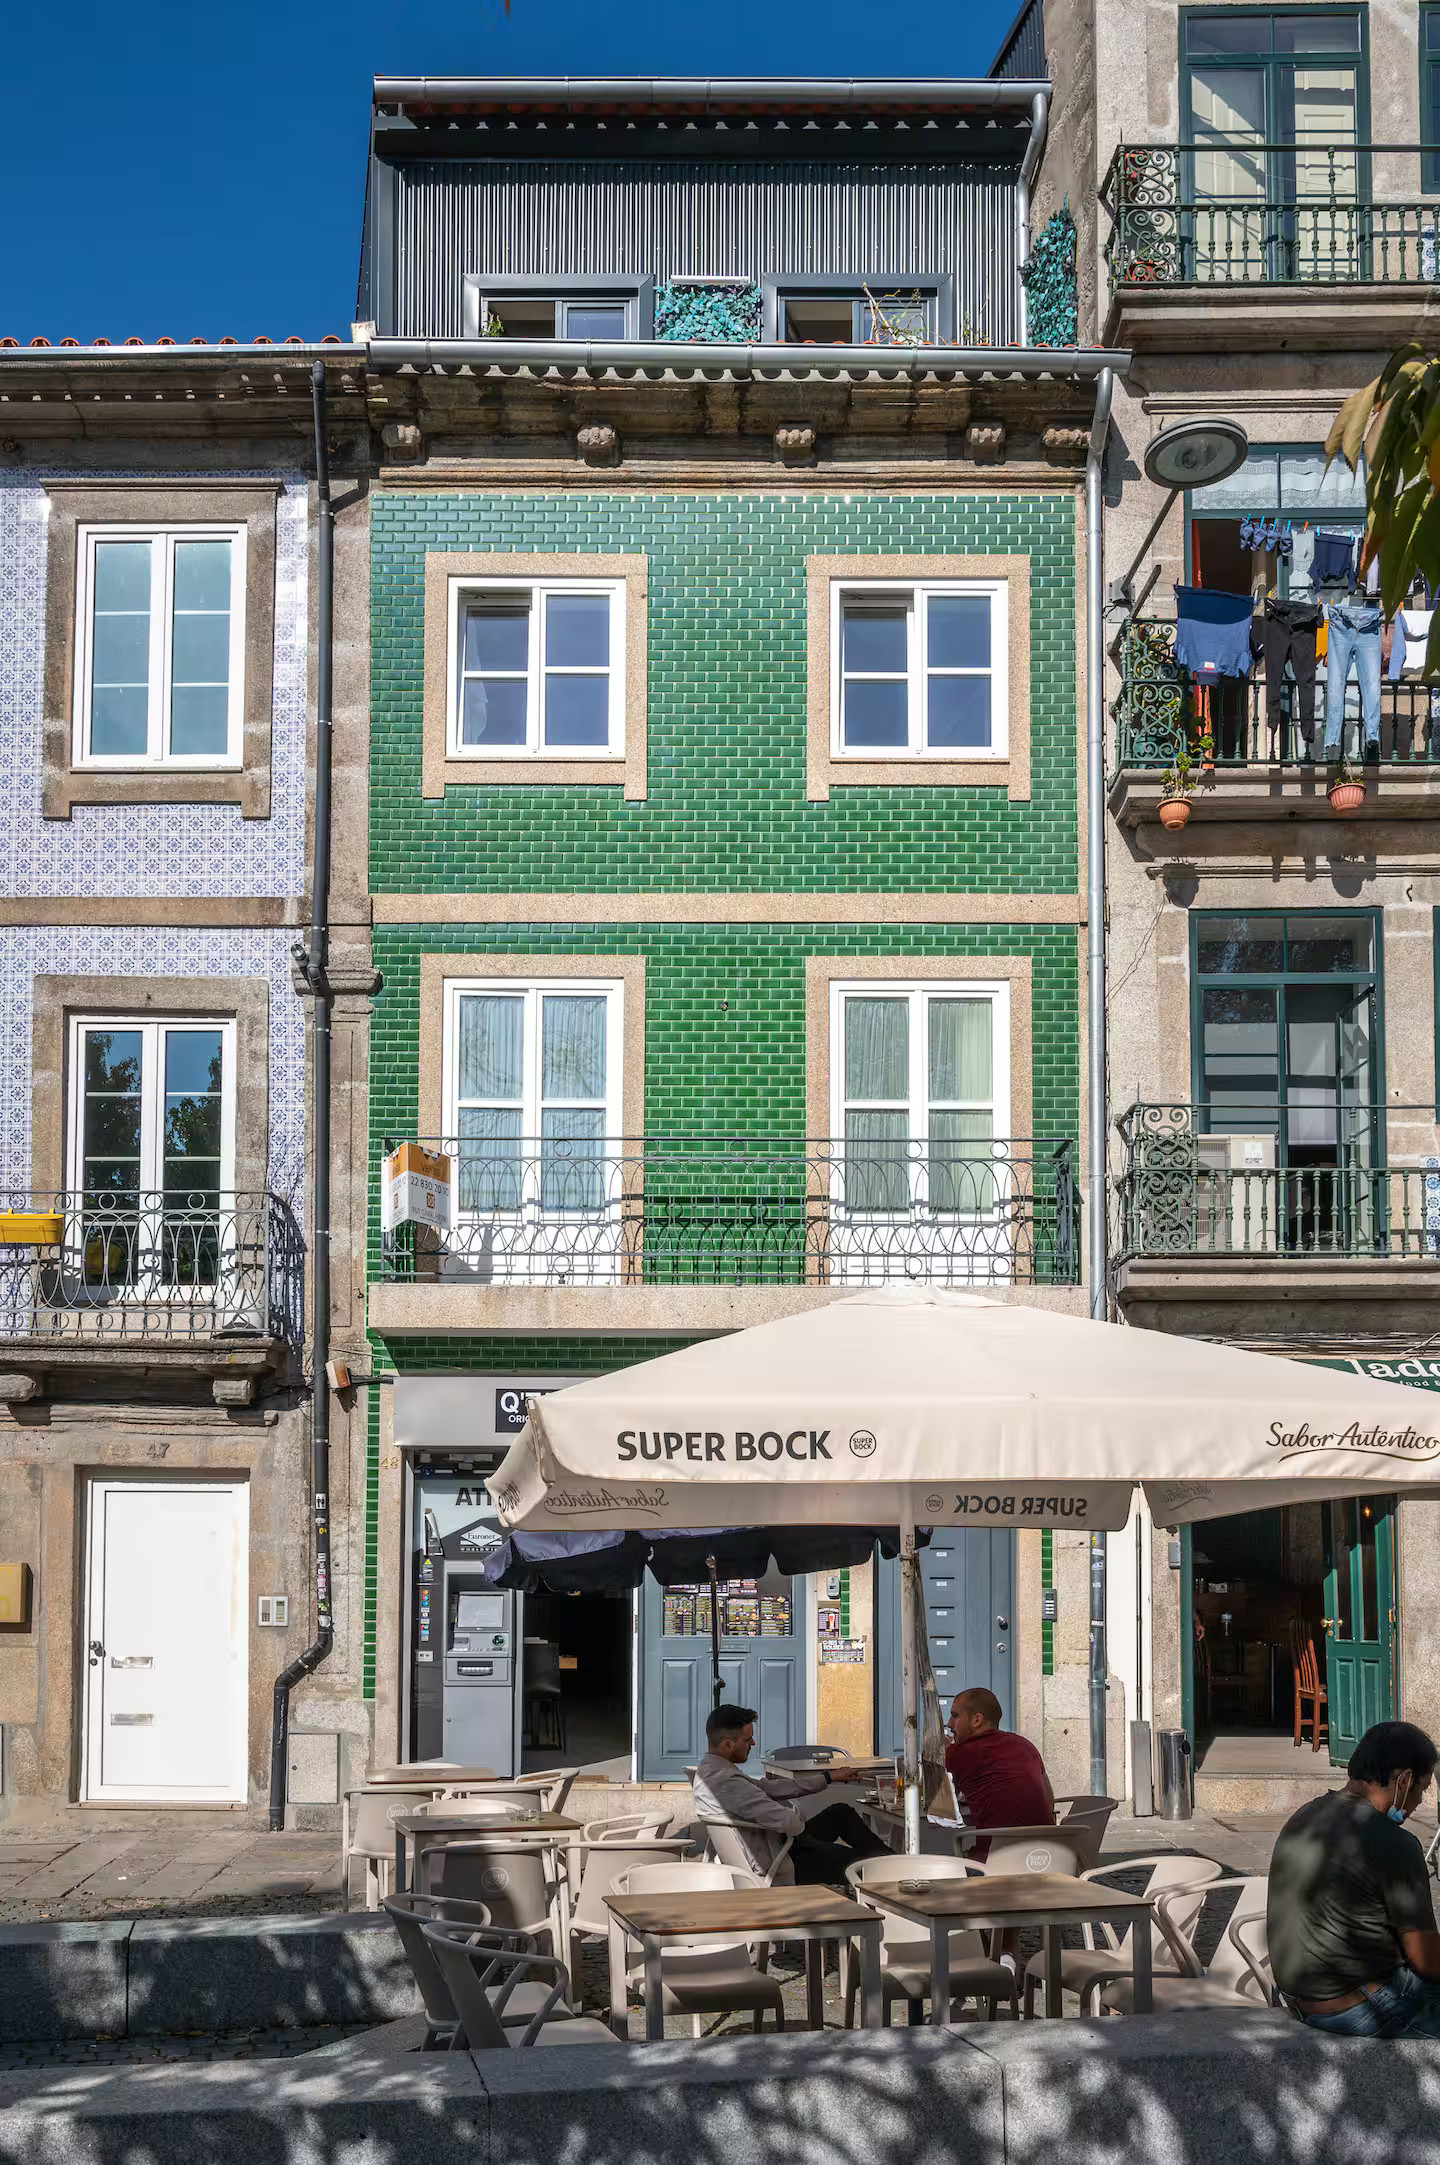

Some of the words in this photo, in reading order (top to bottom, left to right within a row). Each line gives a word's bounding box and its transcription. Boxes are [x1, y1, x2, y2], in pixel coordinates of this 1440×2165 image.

[1265, 1421, 1334, 1447] Sabor
[1333, 1421, 1440, 1450] Autêntico
[146, 1442, 170, 1459] 47
[617, 1430, 726, 1461] SUPER
[735, 1430, 833, 1461] BOCK
[380, 1456, 399, 1470] 48
[467, 1532, 496, 1540] Euronet
